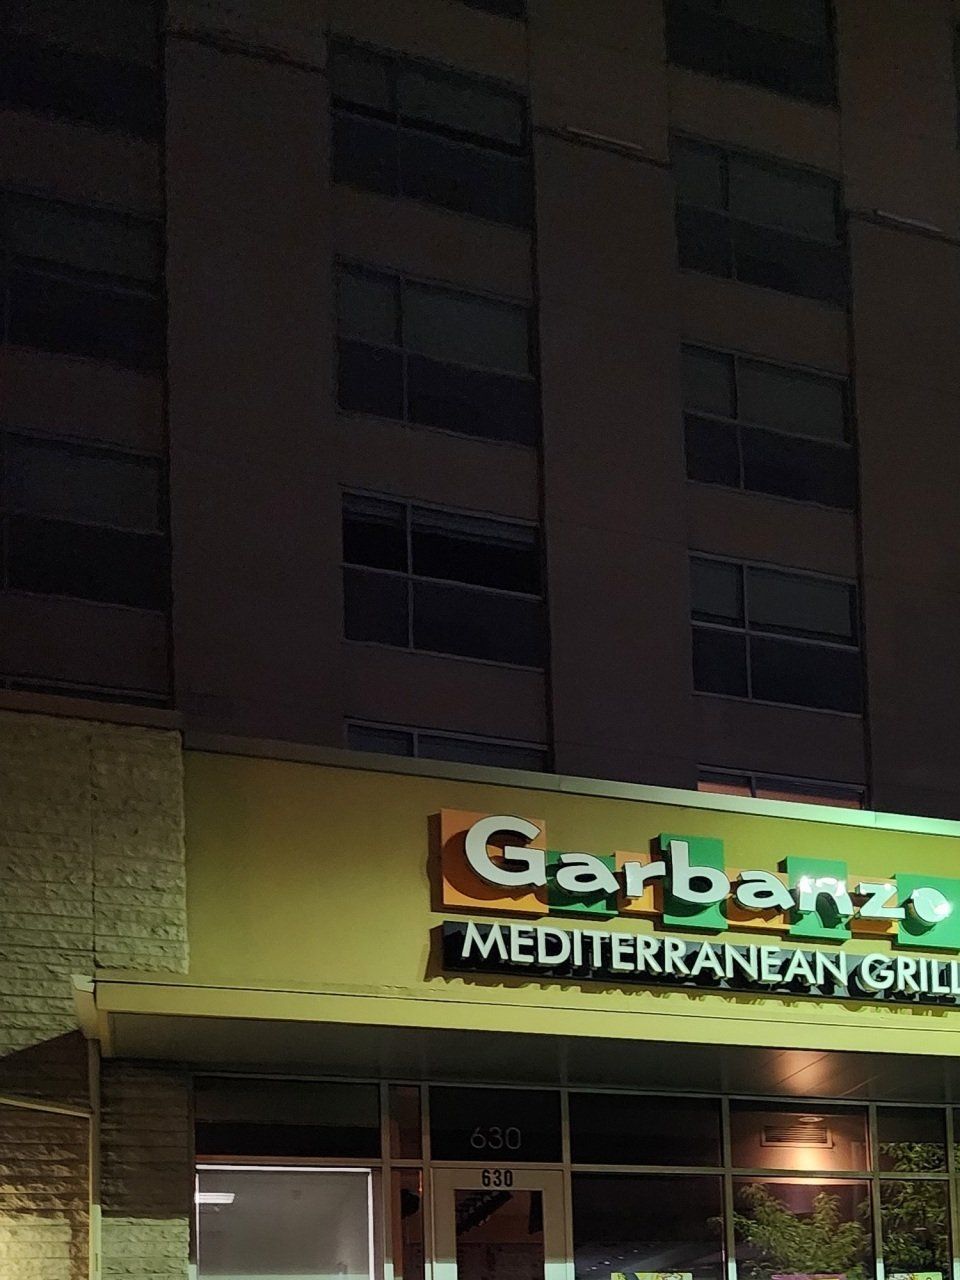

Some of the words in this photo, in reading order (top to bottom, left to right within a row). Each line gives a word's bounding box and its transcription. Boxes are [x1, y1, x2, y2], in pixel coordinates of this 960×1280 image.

[464, 815, 953, 924] Garbanzo
[461, 921, 848, 987] MEDITERRANEAN
[470, 1126, 521, 1150] 630
[481, 1169, 513, 1187] 630
